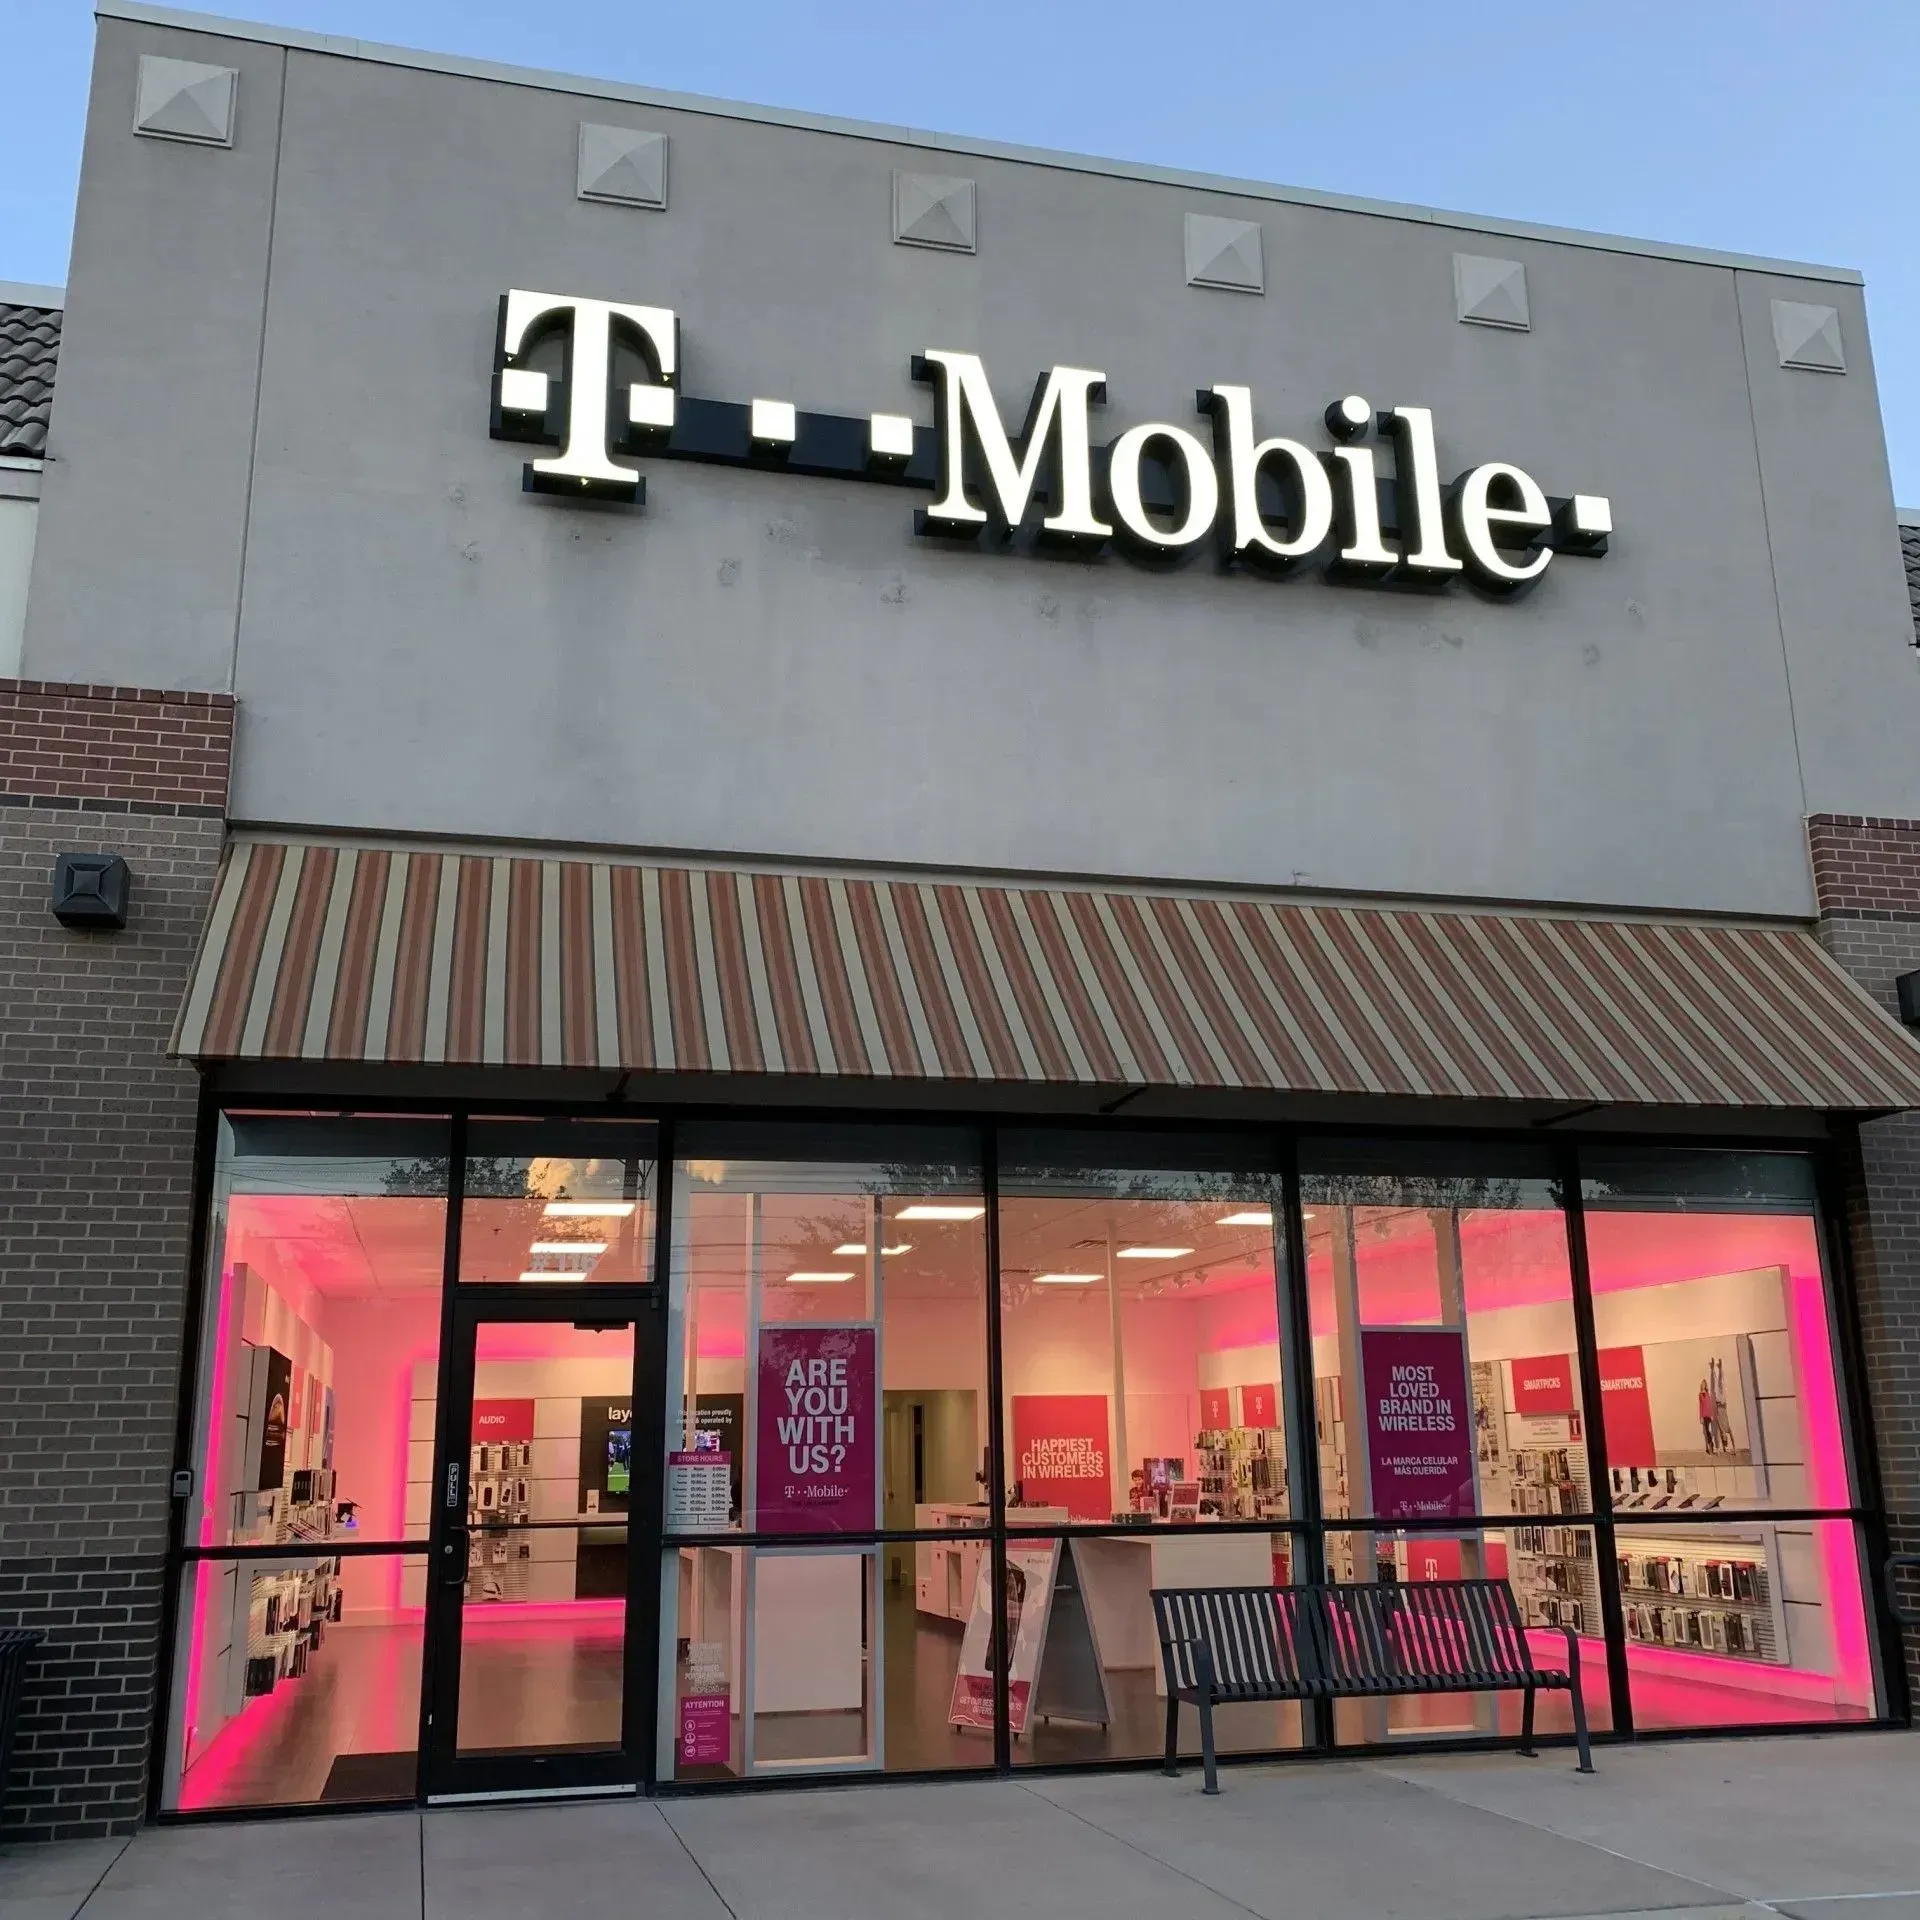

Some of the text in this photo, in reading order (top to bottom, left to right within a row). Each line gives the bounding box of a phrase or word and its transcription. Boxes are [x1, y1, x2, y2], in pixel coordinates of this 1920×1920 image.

[785, 1359, 848, 1386] ARE
[1391, 1365, 1435, 1381] MOST
[1389, 1381, 1440, 1398] LOVED
[1523, 1377, 1561, 1391] SMARTPICKS
[1600, 1376, 1643, 1392] SMARTPICKS
[784, 1387, 848, 1416] YOU
[1380, 1399, 1452, 1415] BRAND IN
[478, 1415, 506, 1424] AUDIO
[1378, 1415, 1456, 1432] WIRELESS
[777, 1416, 855, 1445] WITH
[1030, 1438, 1094, 1453] HAPPIEST
[789, 1444, 848, 1474] US?
[1021, 1451, 1104, 1466] CUSTOMERS
[1381, 1456, 1458, 1466] LA MARCA CELULAR
[1022, 1464, 1104, 1479] IN WIRELESS
[1394, 1464, 1448, 1476] MÁS QUERIDA
[684, 1700, 725, 1709] ATTENTION
